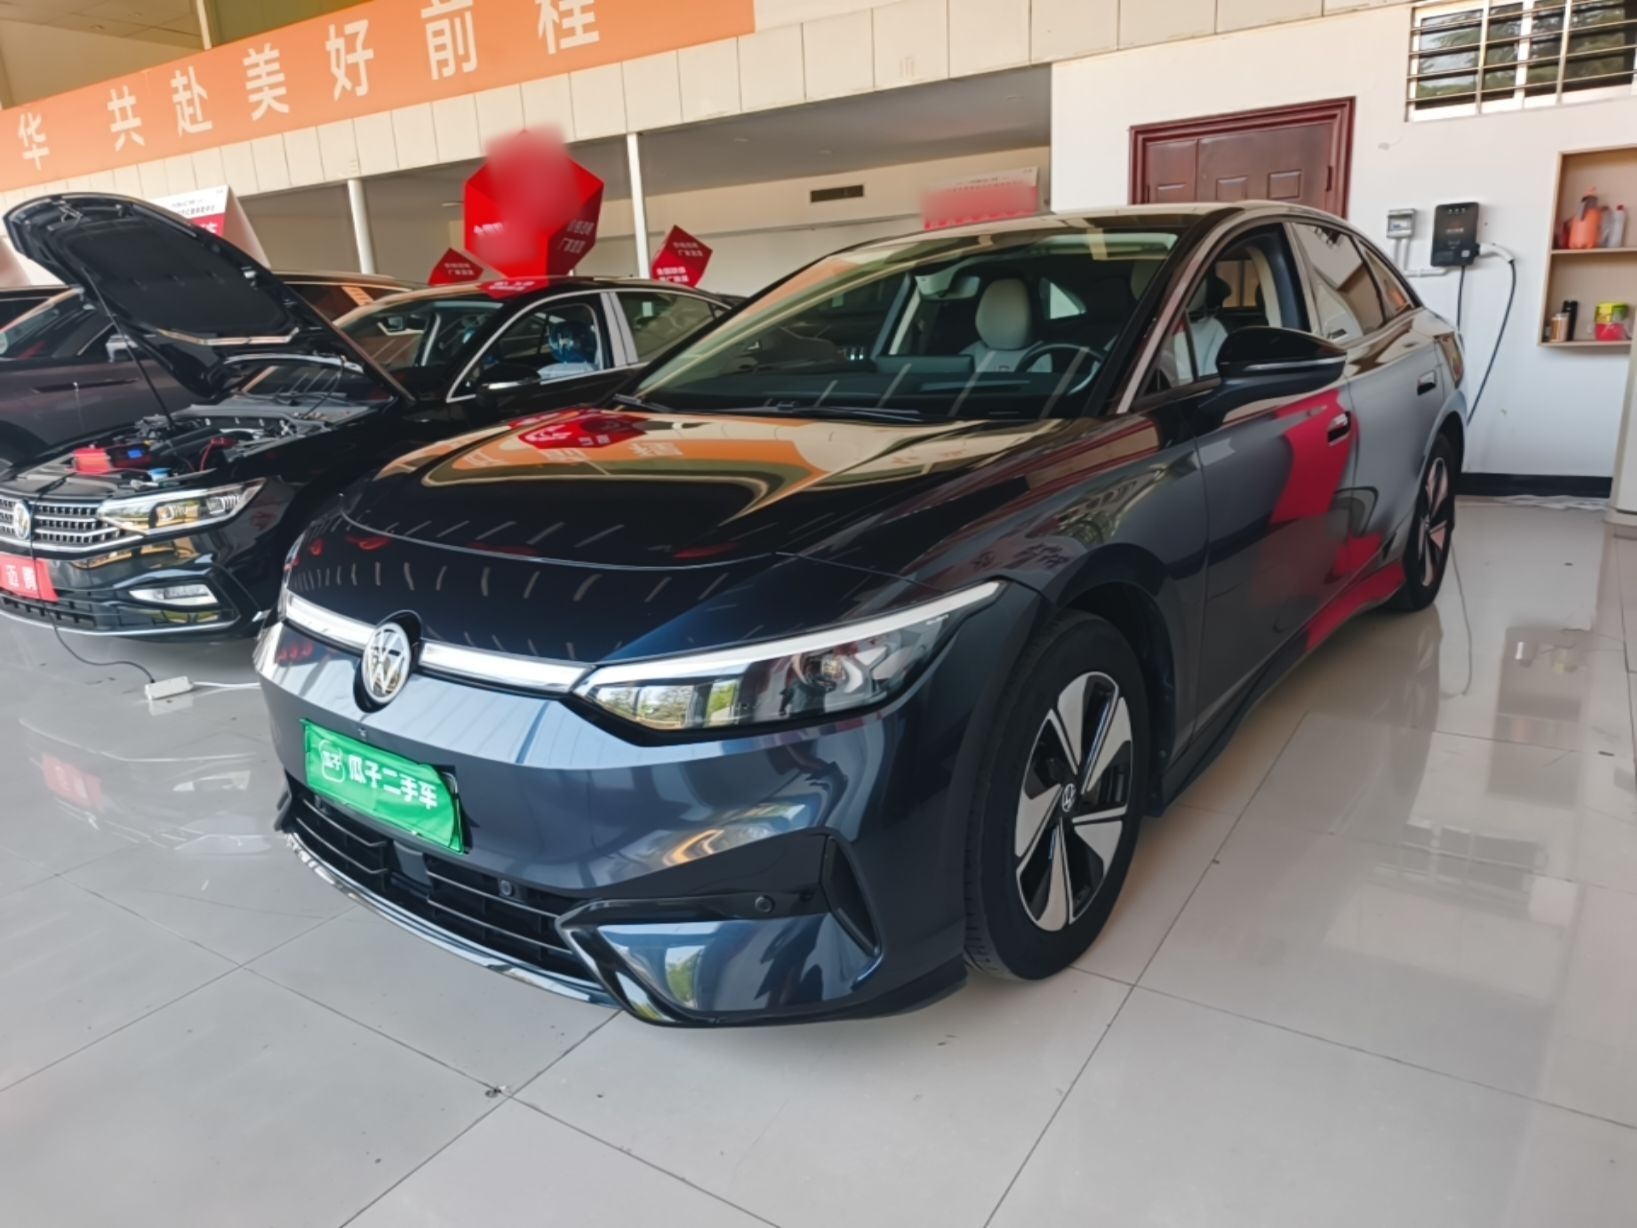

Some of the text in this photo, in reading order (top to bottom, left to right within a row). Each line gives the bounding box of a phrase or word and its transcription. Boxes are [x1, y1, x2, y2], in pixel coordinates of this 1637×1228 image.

[348, 754, 438, 810] 瓜子二手车
